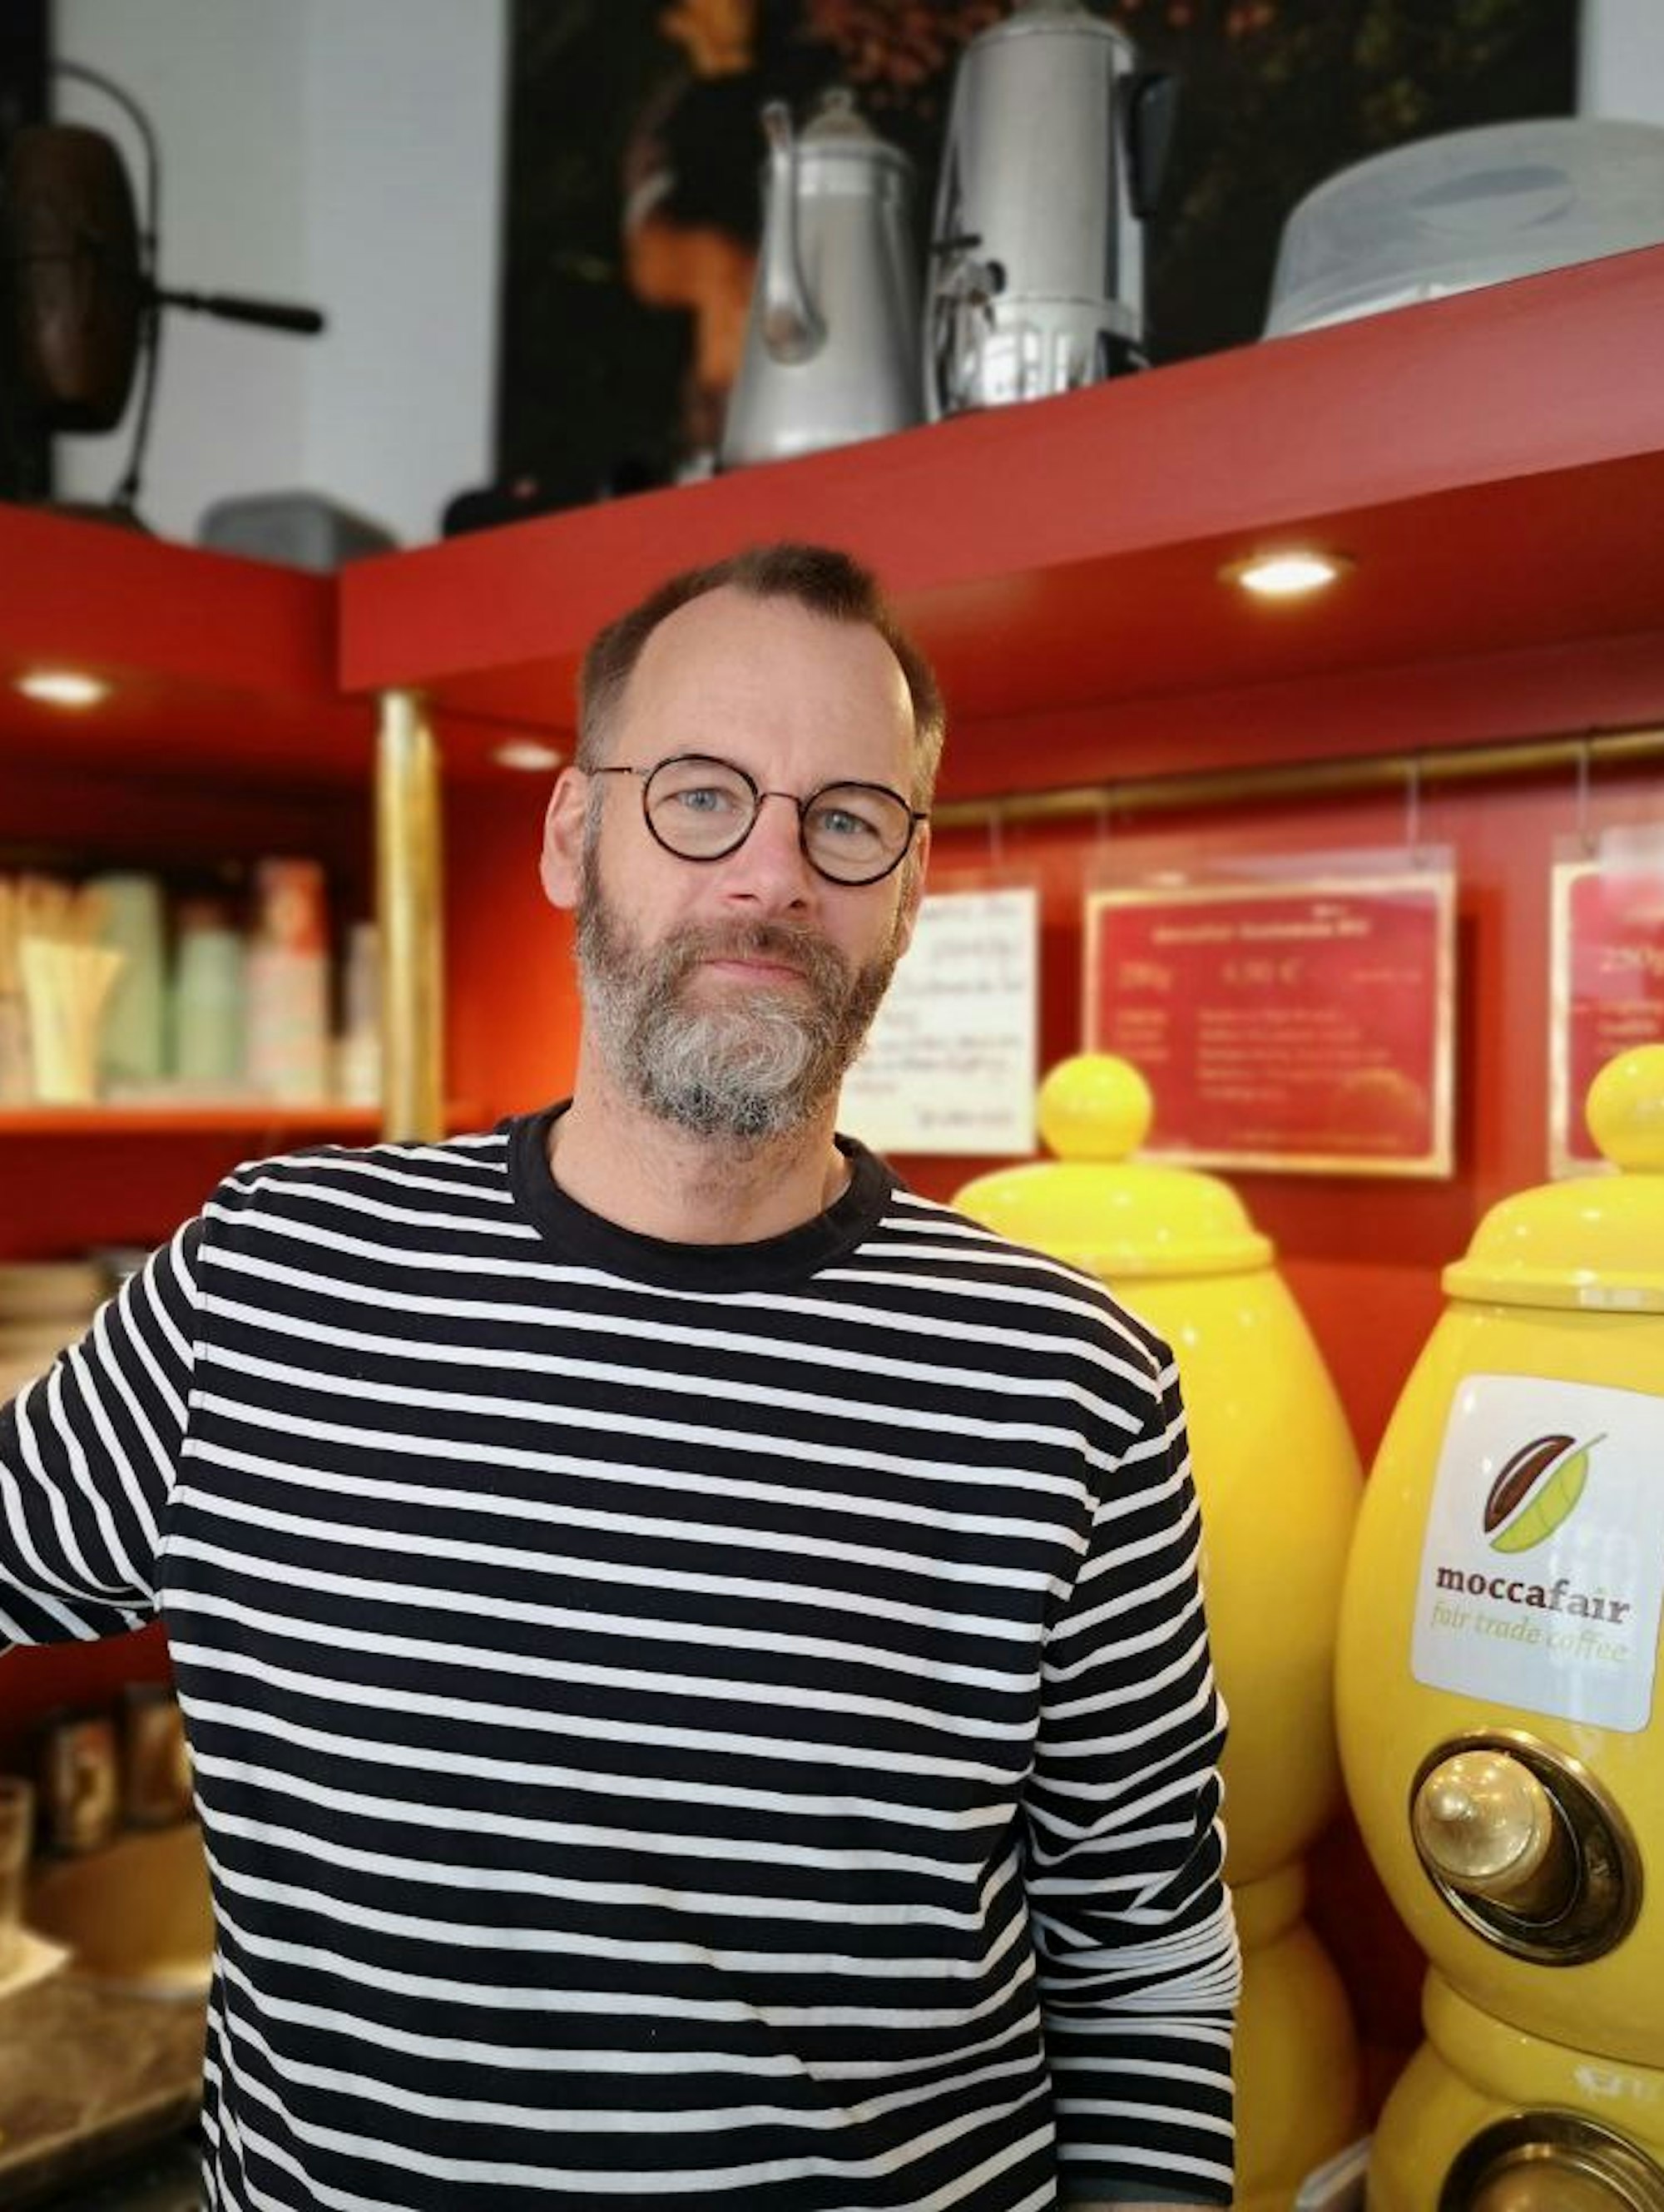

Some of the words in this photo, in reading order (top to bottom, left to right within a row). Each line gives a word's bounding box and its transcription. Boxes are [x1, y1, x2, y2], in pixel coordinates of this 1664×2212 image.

[1435, 1566, 1630, 1624] moccafair
[1430, 1601, 1471, 1630] fair
[1474, 1615, 1543, 1645] trade
[1545, 1628, 1629, 1661] coffee
